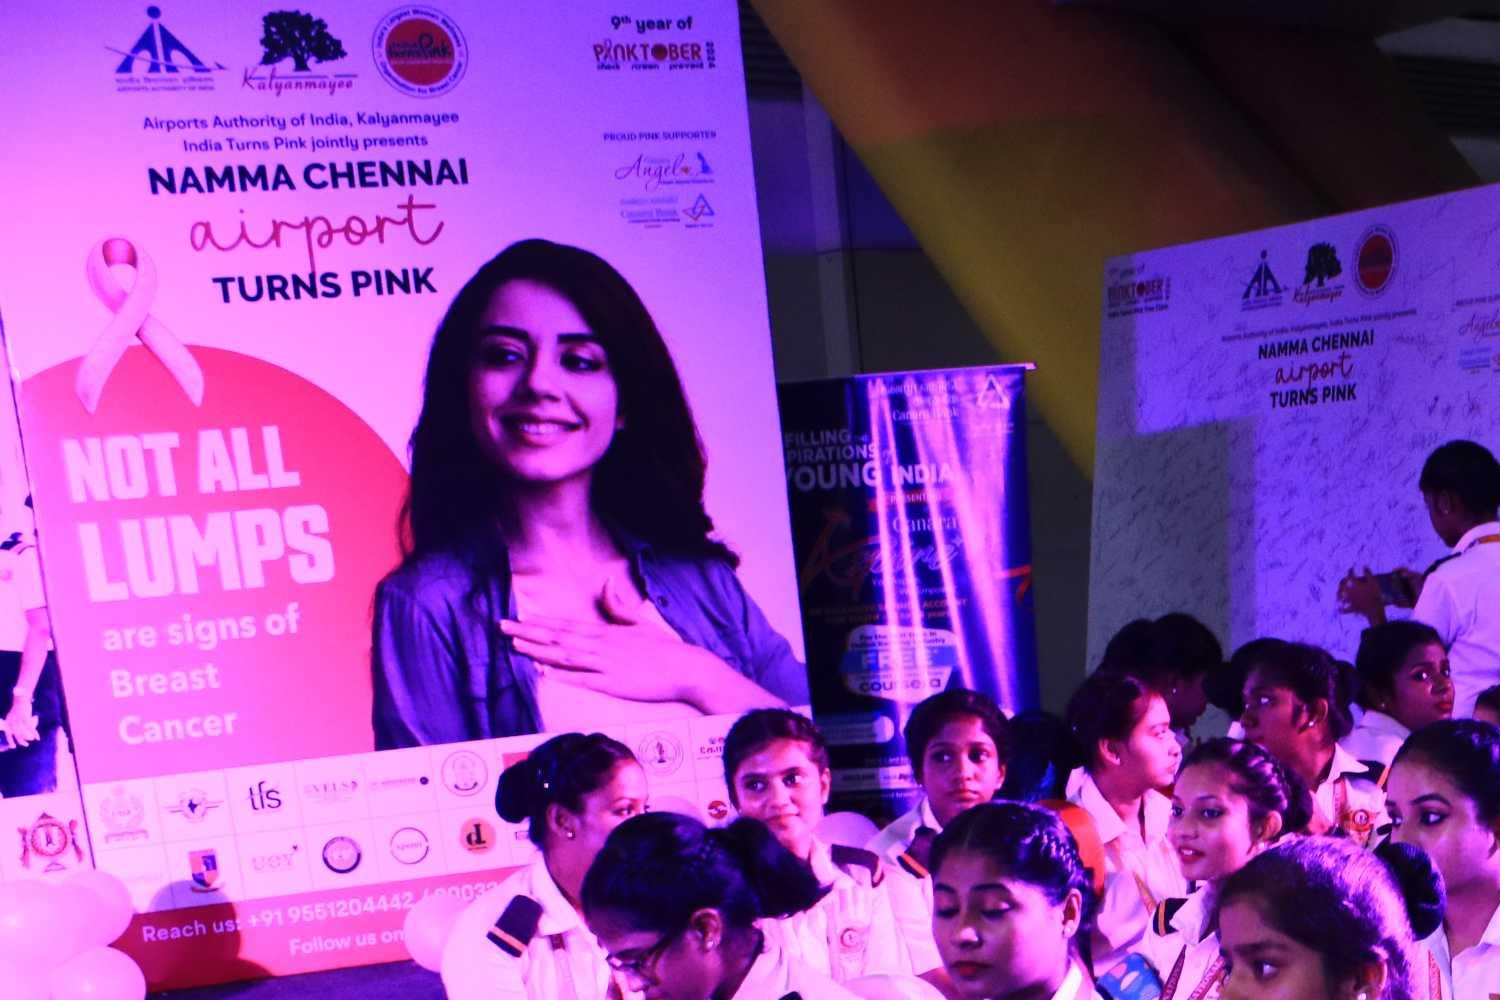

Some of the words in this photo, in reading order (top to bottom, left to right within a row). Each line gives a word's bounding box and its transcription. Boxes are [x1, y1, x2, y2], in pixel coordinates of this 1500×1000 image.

[635, 18, 672, 34] year
[676, 15, 693, 30] of
[242, 66, 354, 97] Kalyanmayee
[143, 116, 209, 132] Airports
[213, 114, 287, 130] Authority
[290, 113, 306, 127] of
[310, 112, 353, 128] India,
[357, 111, 459, 127] Kalyanmayee
[183, 139, 223, 153] India
[226, 138, 270, 151] Turns
[274, 136, 305, 150] Pink
[311, 135, 359, 152] jointly
[363, 134, 428, 150] presents
[148, 164, 296, 195] NAMMA
[303, 157, 470, 190] CHENNAI
[190, 194, 444, 277] airport
[212, 271, 342, 303] TURNS
[351, 266, 438, 298] PINK
[1258, 338, 1308, 360] NAMMA
[1311, 329, 1374, 352] CHENNAI
[1275, 351, 1354, 390] airport
[1269, 387, 1319, 409] TURNS
[1322, 383, 1358, 403] PINK
[785, 428, 851, 448] FILLING
[787, 444, 877, 464] PIRATIONS
[61, 431, 180, 504] NOT
[199, 425, 301, 494] ALL
[76, 504, 336, 603] LUMPS
[103, 625, 157, 651] are
[168, 613, 257, 650] signs
[266, 602, 299, 636] of
[110, 662, 221, 698] Breast
[118, 711, 238, 745] Cancer
[141, 920, 207, 943] Reach
[213, 917, 242, 934] us:
[247, 907, 284, 928] +91
[287, 891, 414, 923] 9551204442
[289, 936, 351, 957] Follow
[354, 934, 378, 952] us
